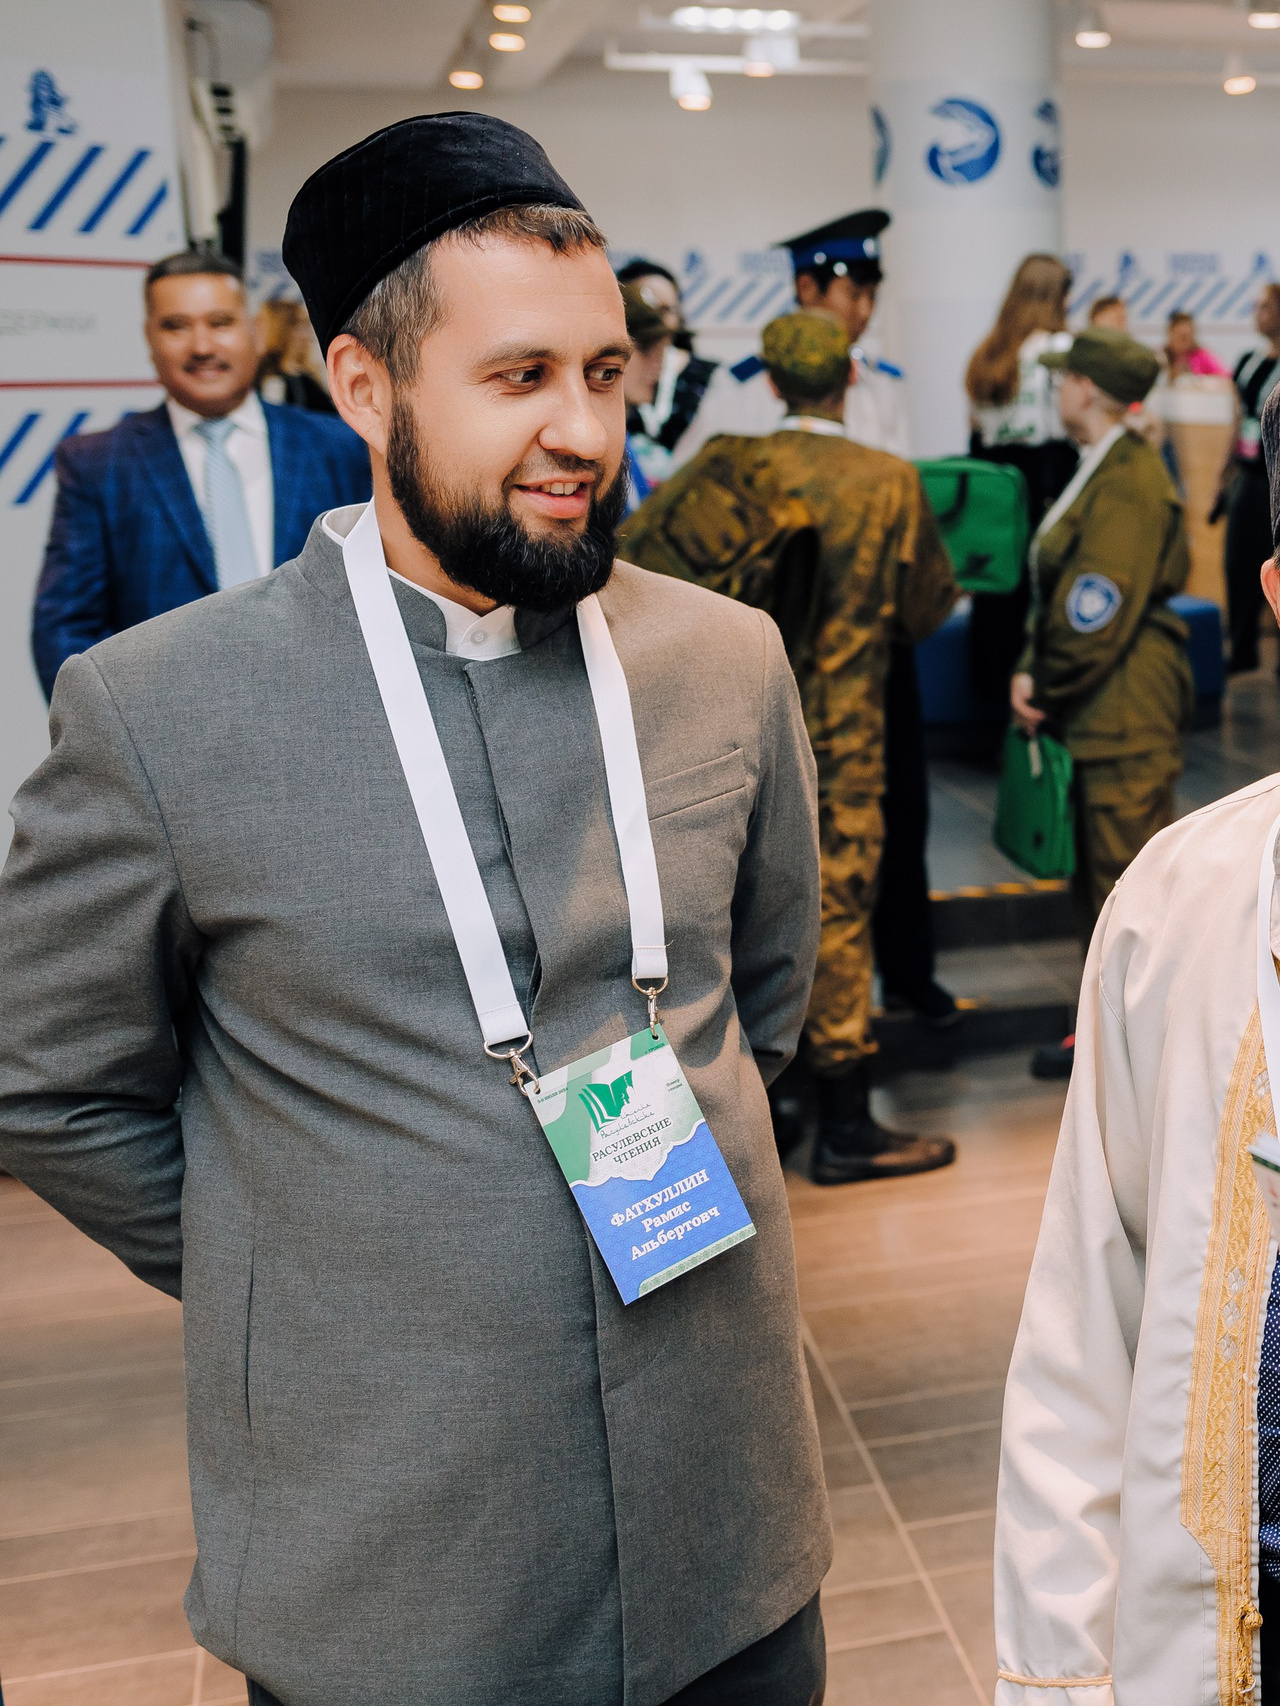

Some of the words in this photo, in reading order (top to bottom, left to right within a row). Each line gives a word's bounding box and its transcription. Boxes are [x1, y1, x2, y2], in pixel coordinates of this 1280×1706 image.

[592, 1117, 672, 1162] РАСУЛЕВСКИЕ
[612, 1136, 662, 1164] ЧТЕНИЯ
[610, 1168, 710, 1227] ФАТХУЛЛИН
[641, 1201, 692, 1233] Рамис
[631, 1206, 721, 1261] Альбертовч
